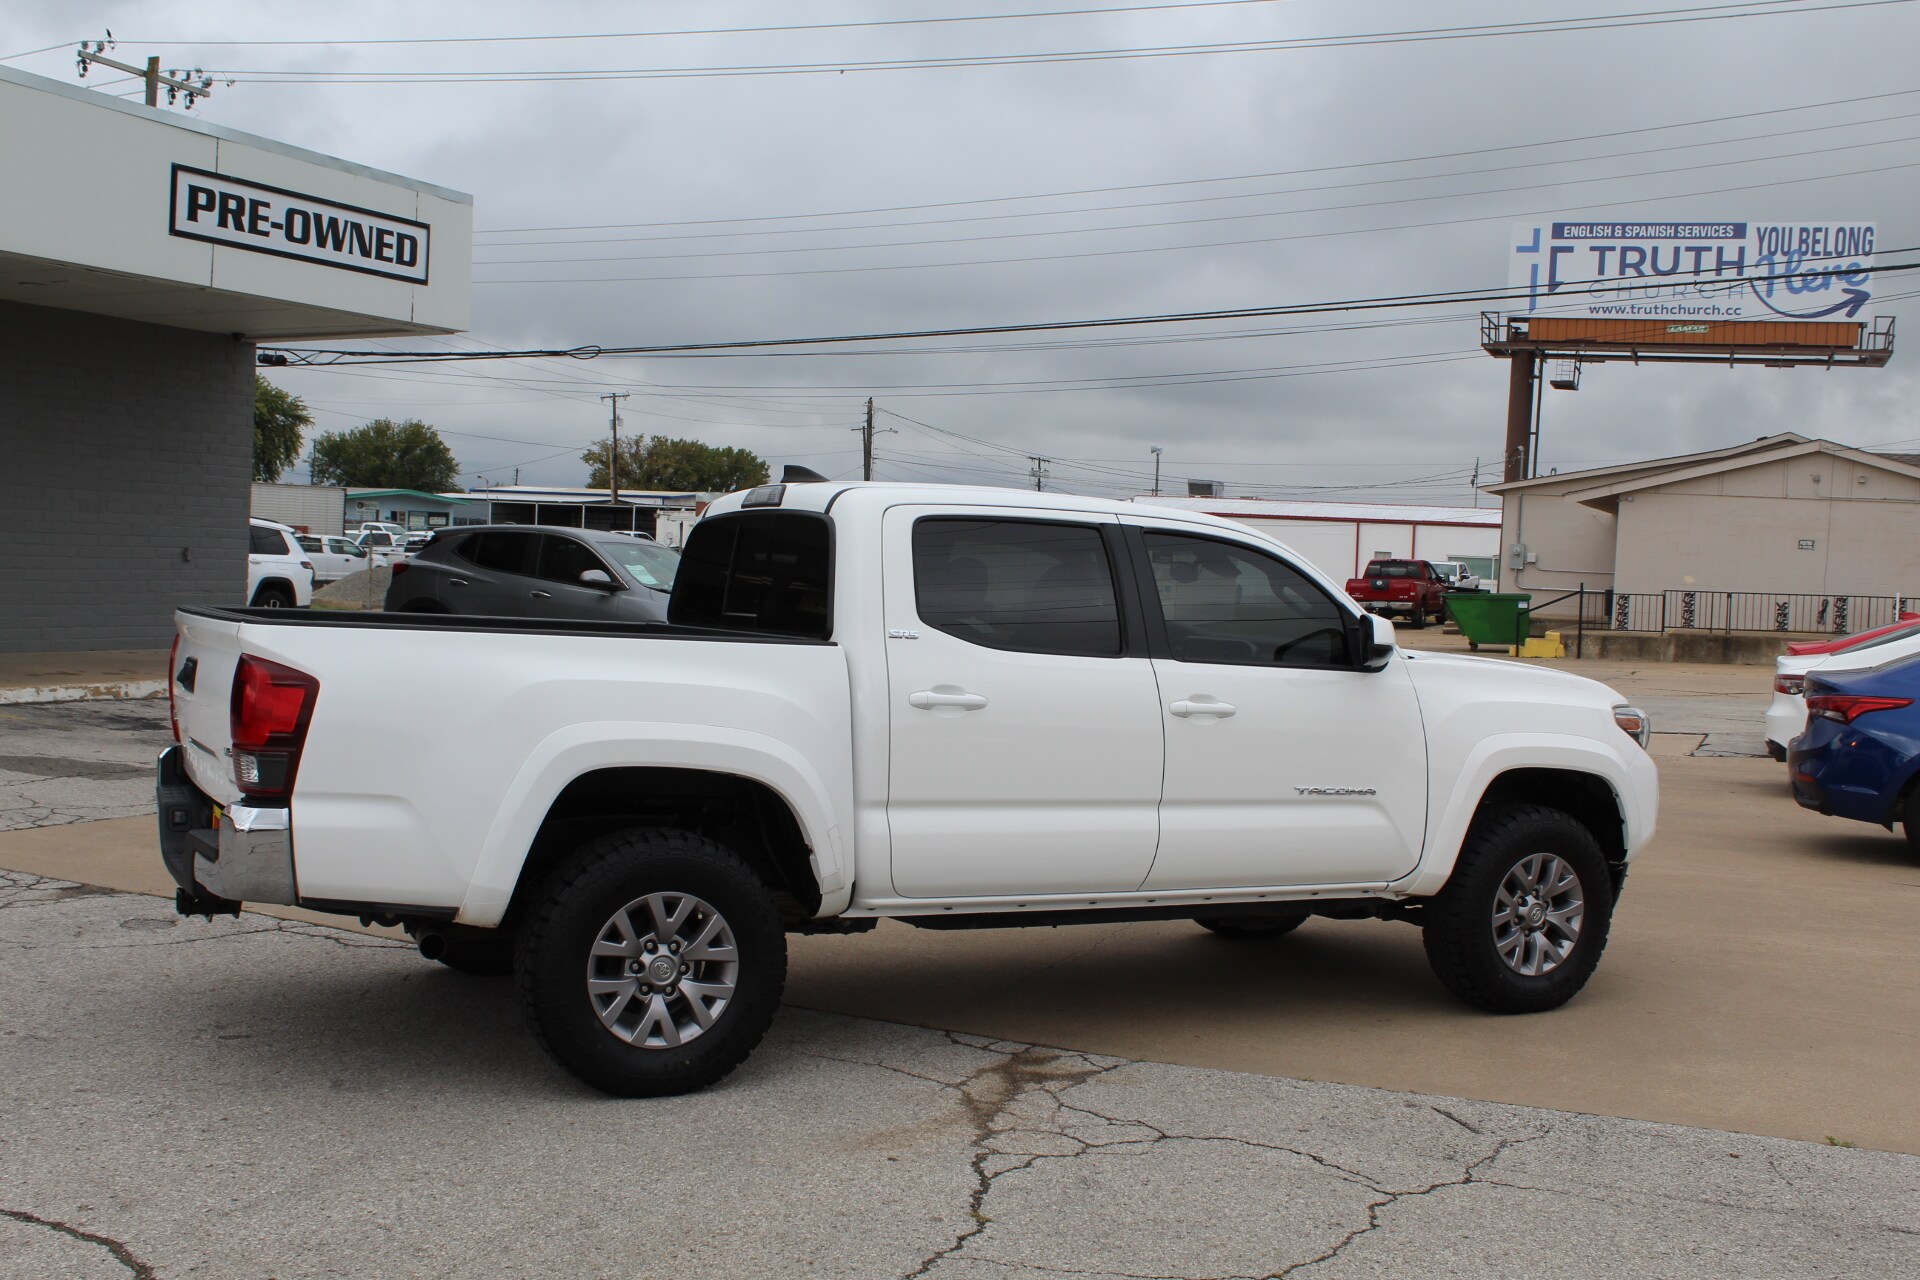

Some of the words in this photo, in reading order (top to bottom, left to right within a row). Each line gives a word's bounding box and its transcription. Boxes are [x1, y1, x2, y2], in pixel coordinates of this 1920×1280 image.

[186, 184, 418, 268] PRE-OWNED
[1563, 225, 1612, 238] ENGLISH
[1614, 225, 1623, 238] &
[1624, 225, 1675, 238] SPANISH
[1677, 225, 1735, 238] SERVICES
[1756, 226, 1793, 257] YOU
[1798, 226, 1874, 257] BELONG
[1589, 245, 1746, 277] TRUTH
[1755, 248, 1870, 299] Here
[1589, 281, 1744, 300] CHURCH
[1589, 303, 1742, 316] www.truthchurch.cc
[1293, 786, 1377, 796] TACOMA
